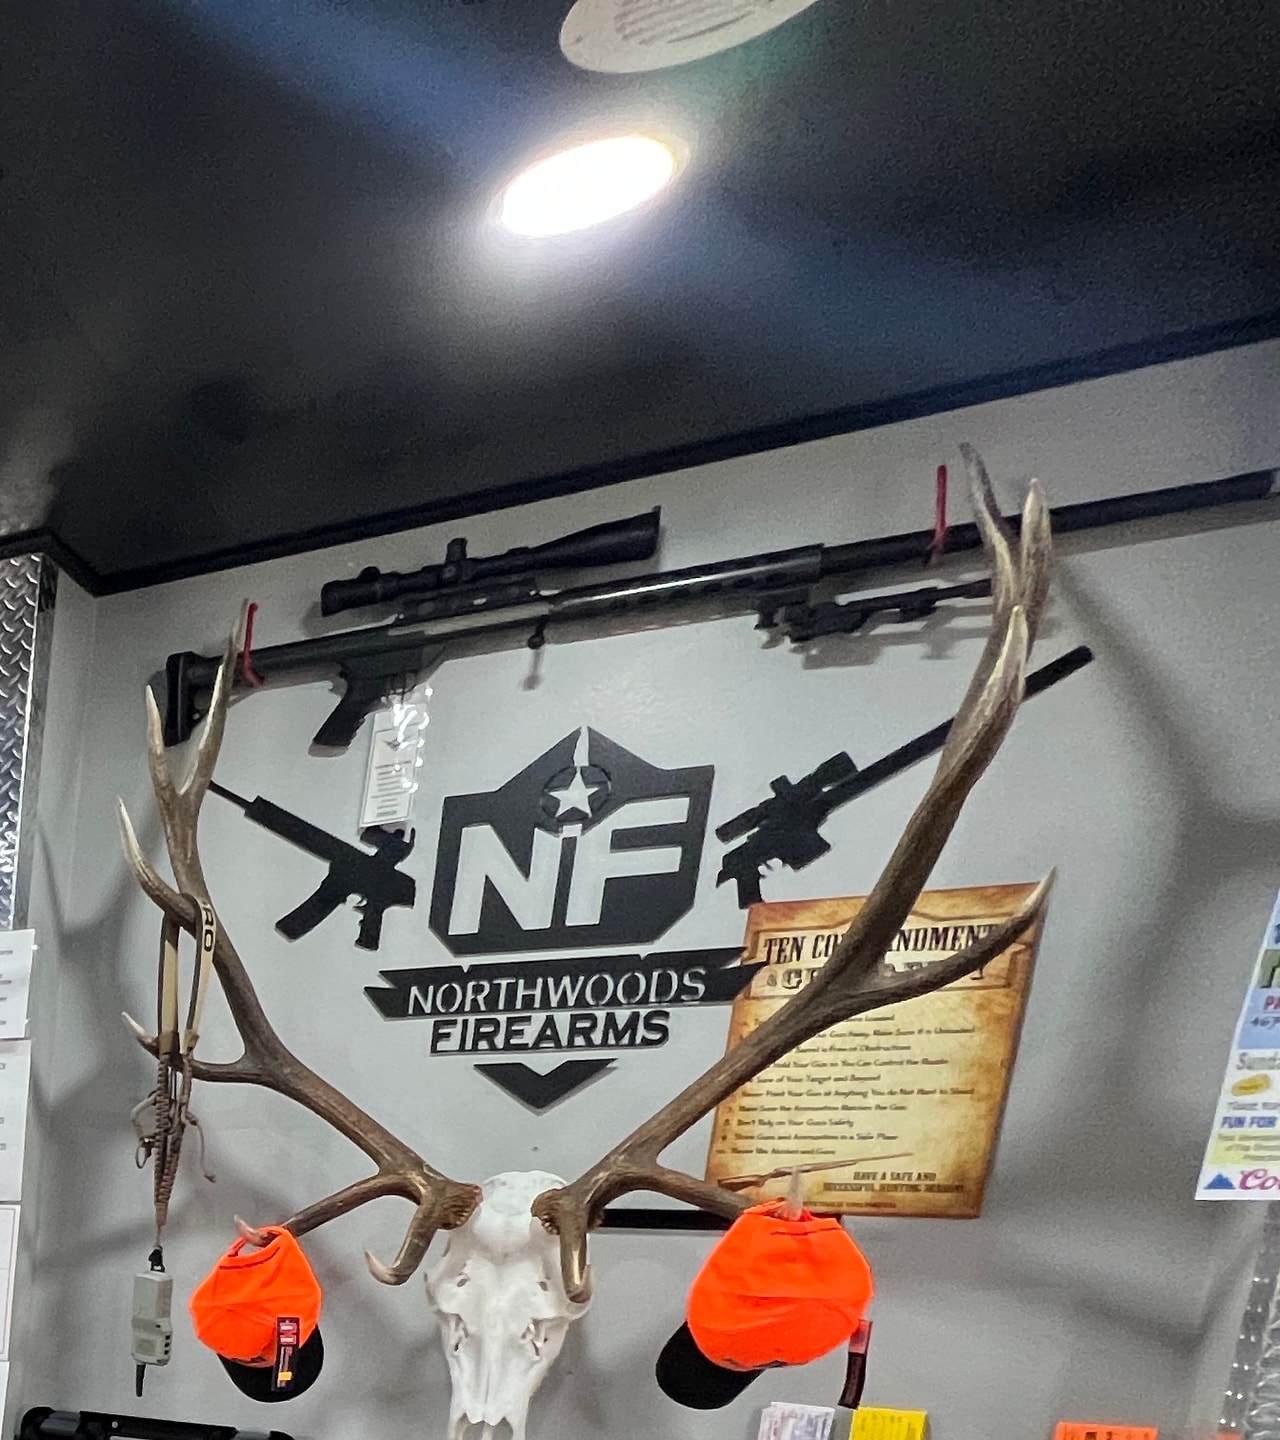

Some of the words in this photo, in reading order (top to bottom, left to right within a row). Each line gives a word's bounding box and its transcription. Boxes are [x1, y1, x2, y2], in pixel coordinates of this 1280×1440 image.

[448, 796, 690, 935] NF
[763, 936, 804, 966] TEN
[407, 967, 706, 1016] NORTHWOODS
[430, 1010, 670, 1056] FIREARMS
[1239, 1168, 1280, 1190] Co
